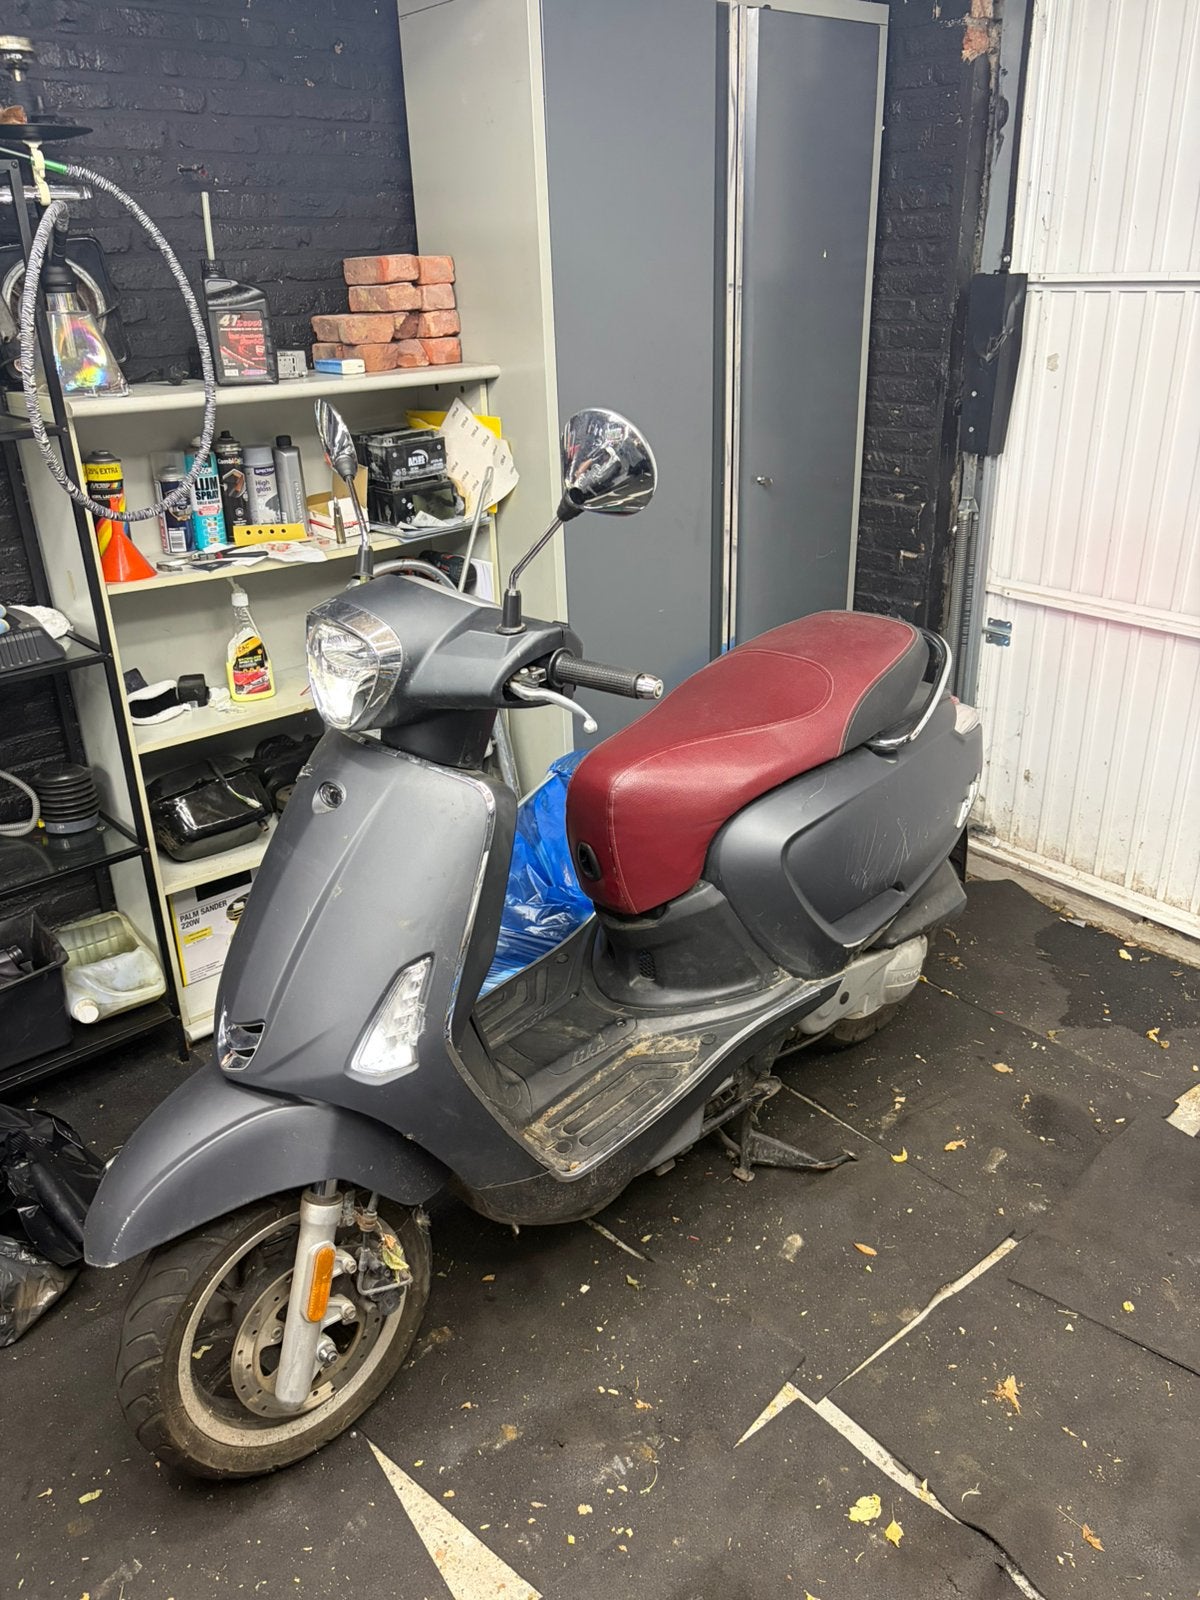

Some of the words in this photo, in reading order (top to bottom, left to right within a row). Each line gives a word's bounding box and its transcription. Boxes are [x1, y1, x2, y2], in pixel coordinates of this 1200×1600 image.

[99, 467, 119, 475] EXTRA
[195, 476, 218, 491] LIJM
[255, 479, 270, 488] High
[195, 490, 219, 501] SPRAY
[256, 486, 272, 494] gloss
[179, 909, 200, 923] PALM
[200, 899, 228, 915] SANDER
[181, 918, 201, 930] 220W
